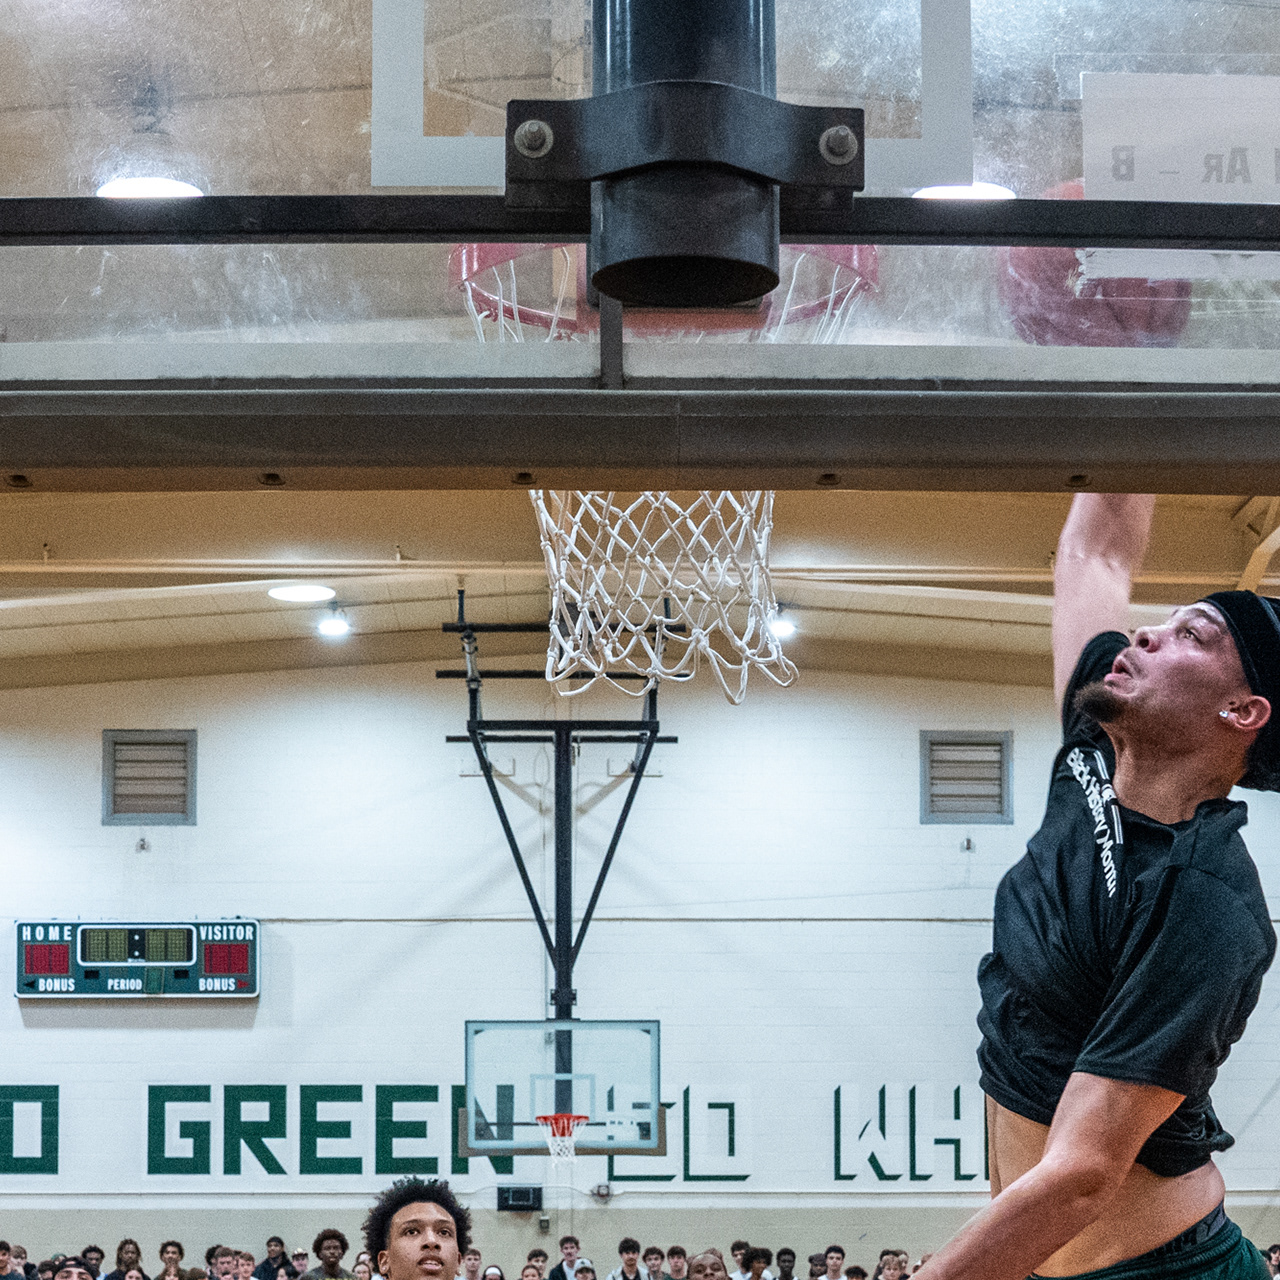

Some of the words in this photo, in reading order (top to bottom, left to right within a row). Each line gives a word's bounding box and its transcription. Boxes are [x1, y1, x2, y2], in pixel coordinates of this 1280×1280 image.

[22, 925, 72, 941] HOME
[199, 925, 254, 941] VISITOR
[38, 978, 75, 992] BONUS
[107, 978, 143, 991] PERIOD
[199, 977, 236, 992] BONUS
[147, 1084, 515, 1175] GREEN
